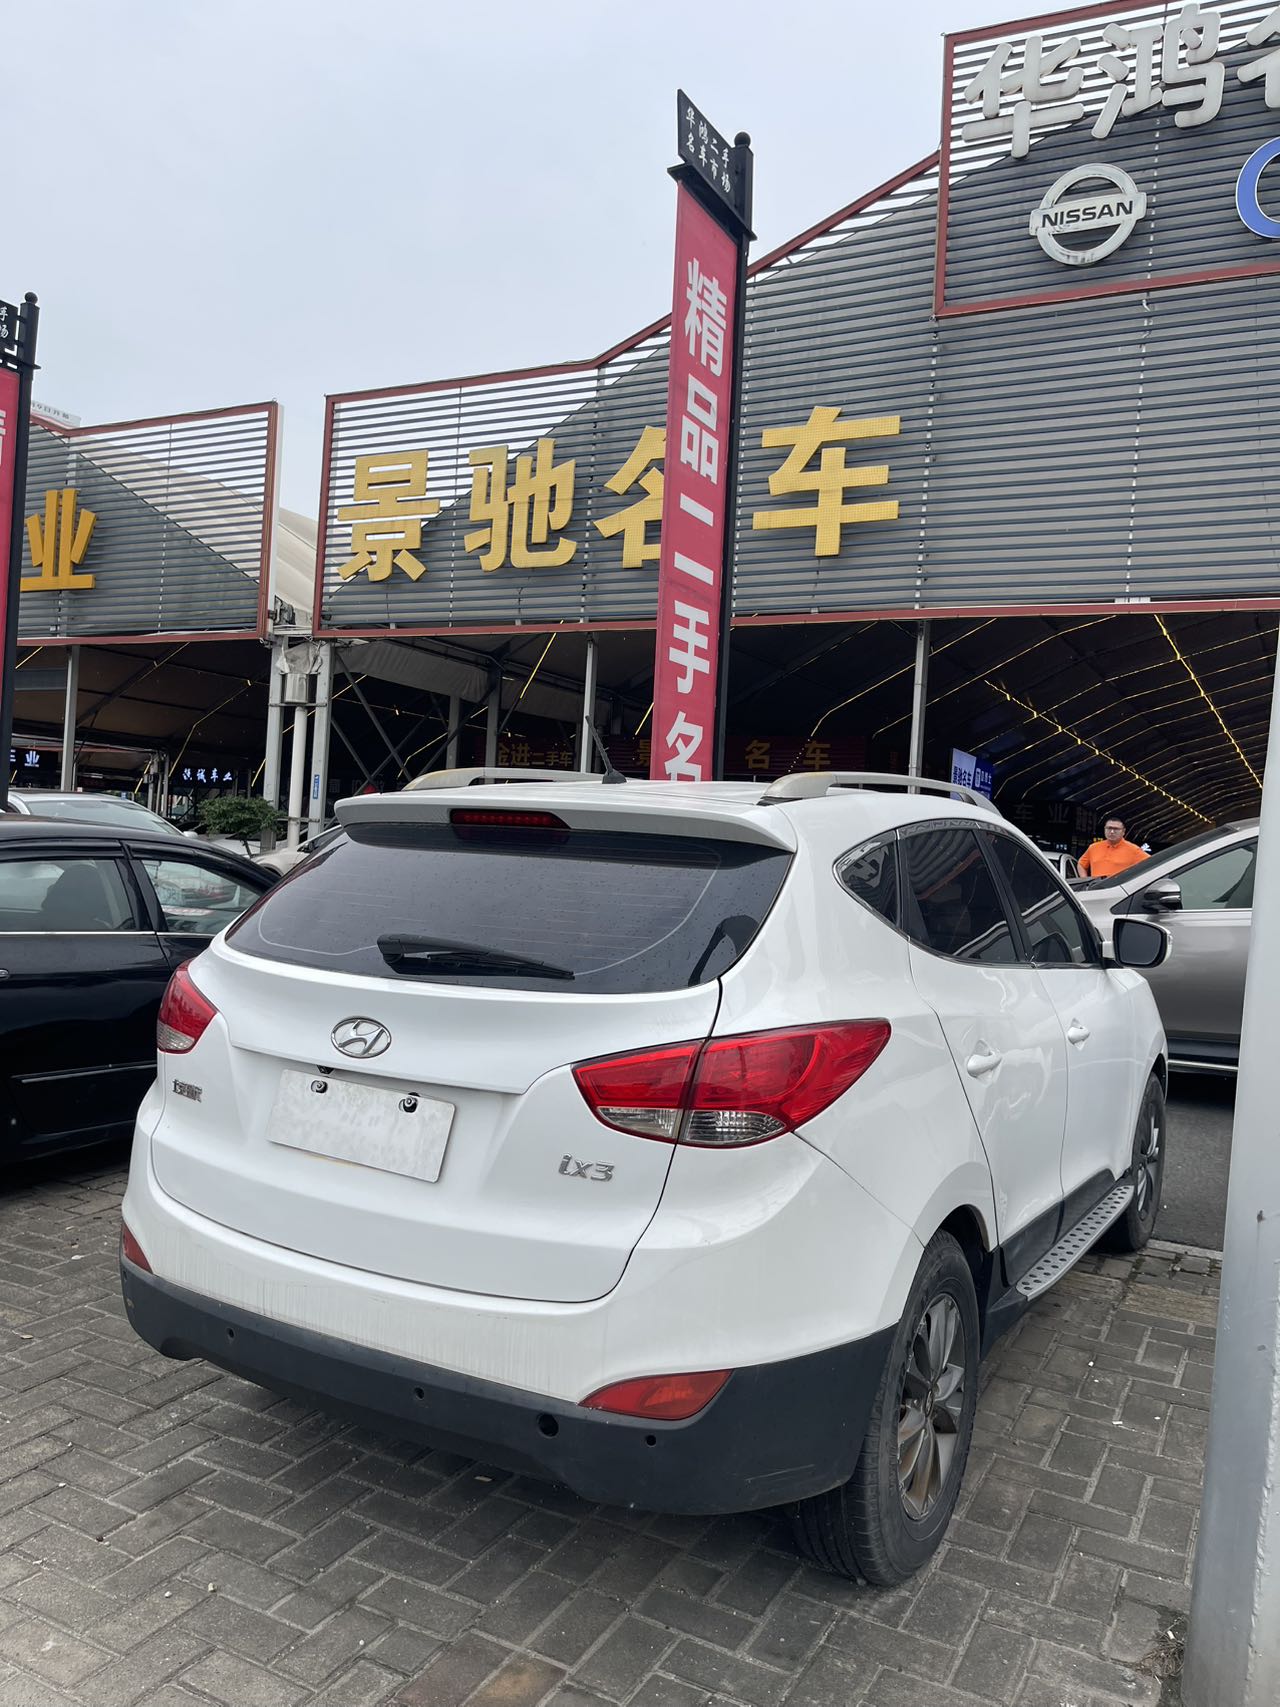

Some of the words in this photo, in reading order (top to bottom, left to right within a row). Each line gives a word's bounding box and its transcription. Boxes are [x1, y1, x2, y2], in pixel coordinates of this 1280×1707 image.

[1041, 200, 1134, 228] NISSAN
[20, 488, 97, 592] 业
[558, 1153, 615, 1182] ix3
